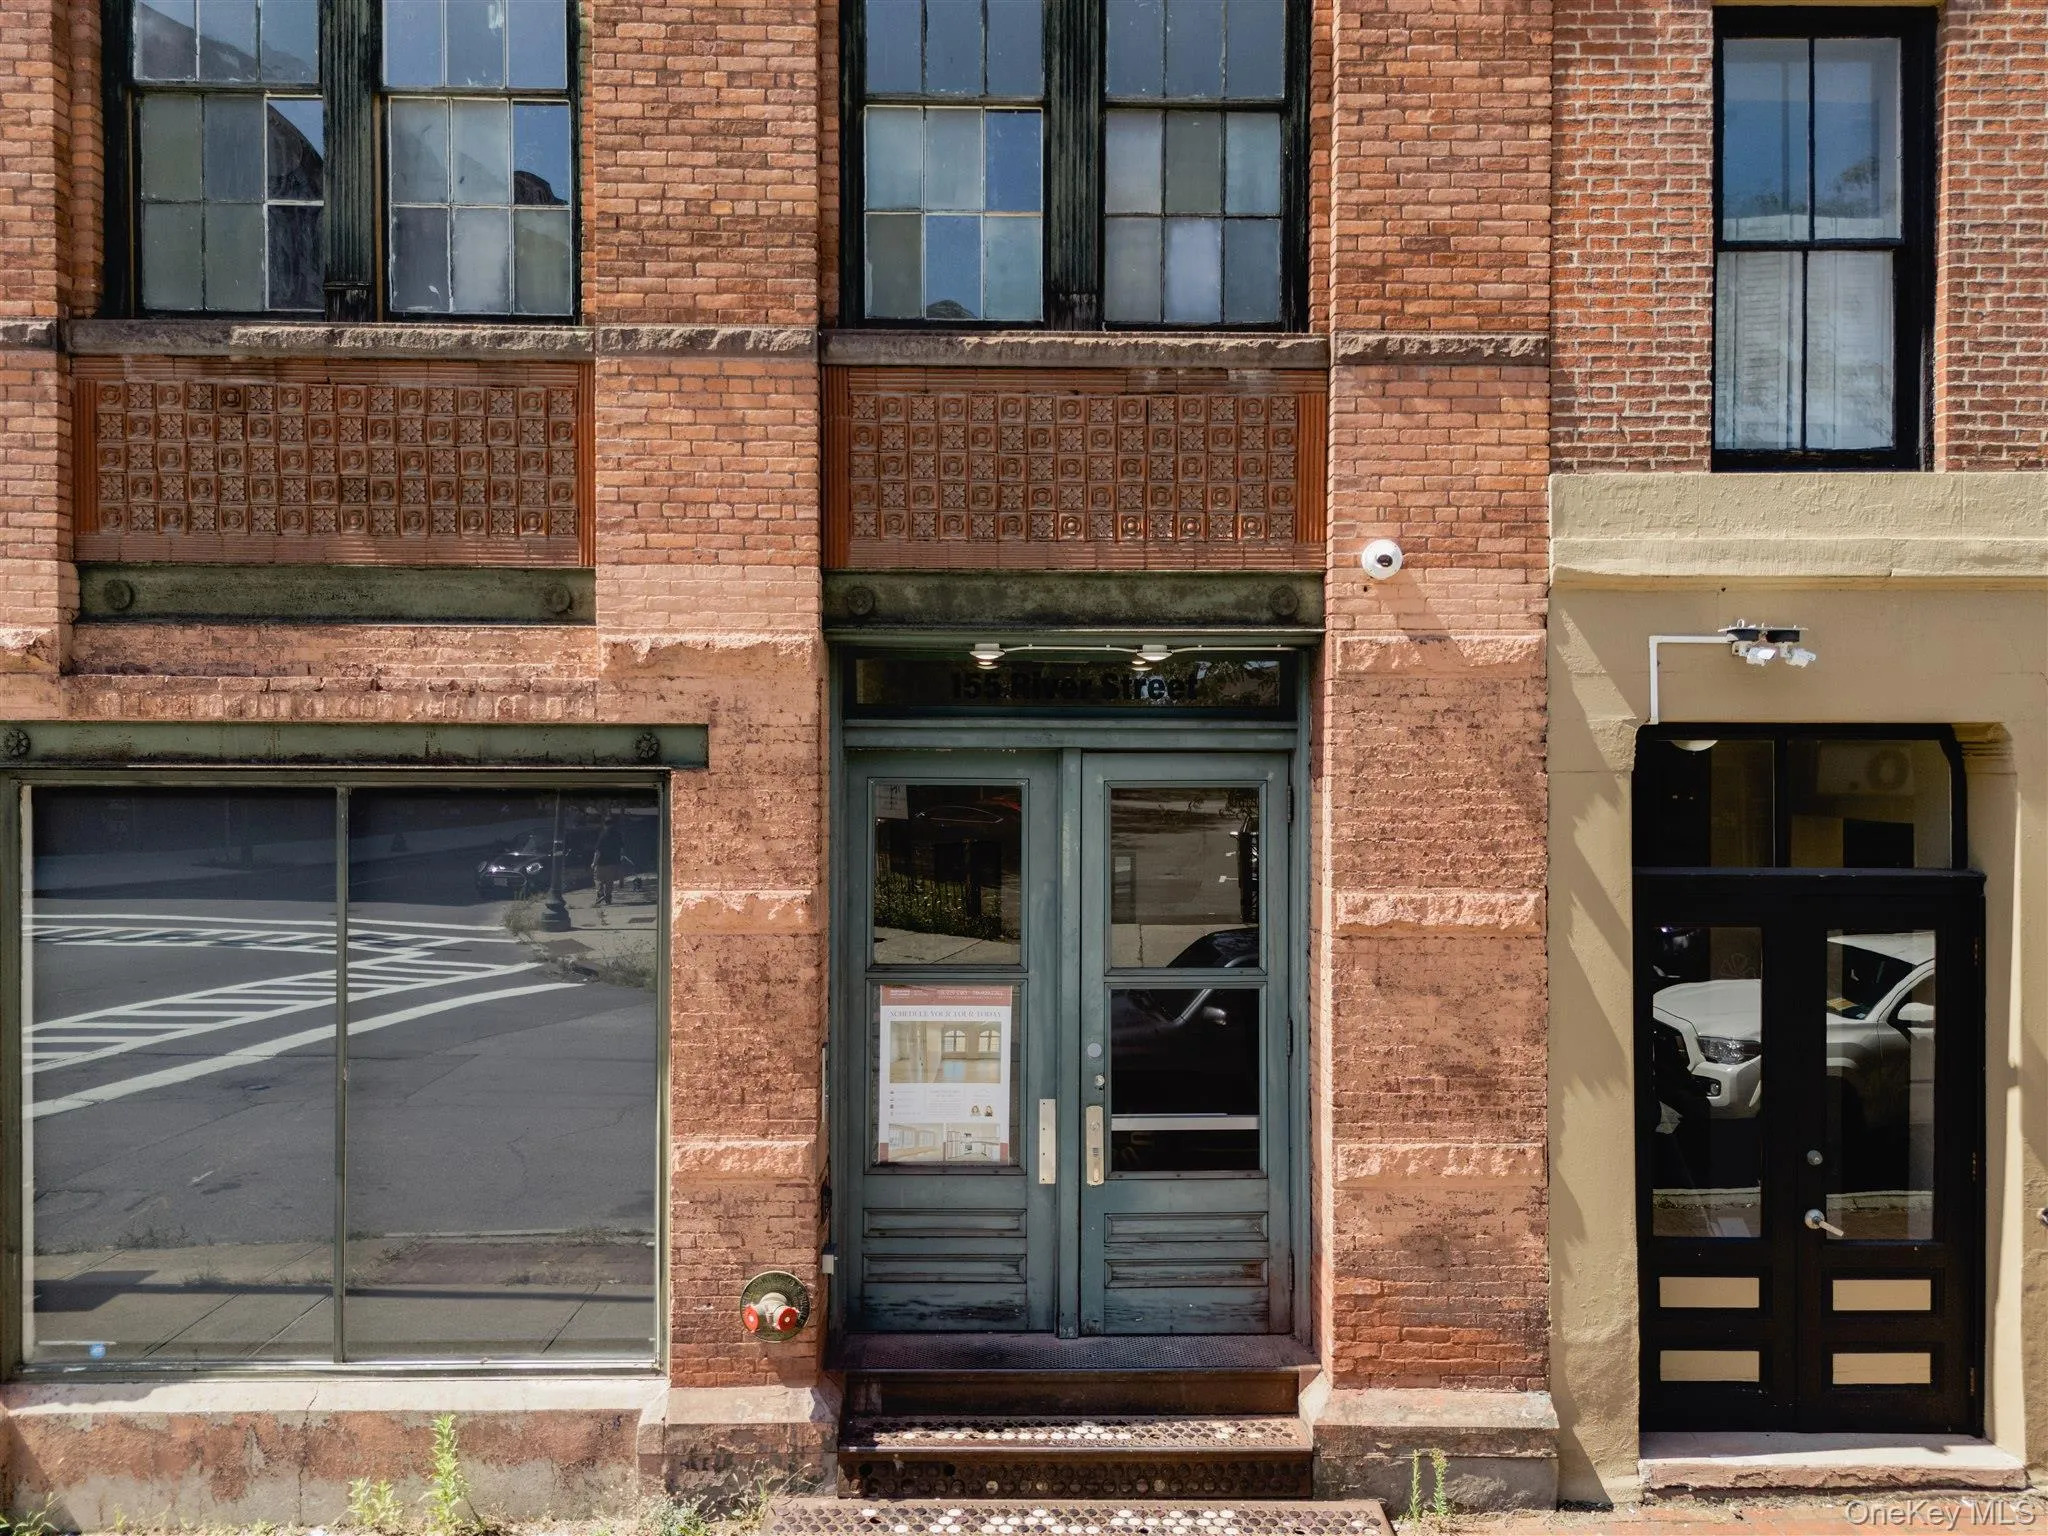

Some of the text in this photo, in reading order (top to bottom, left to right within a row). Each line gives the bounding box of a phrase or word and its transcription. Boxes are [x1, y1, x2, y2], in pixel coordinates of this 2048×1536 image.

[951, 672, 1198, 700] 155 River Street
